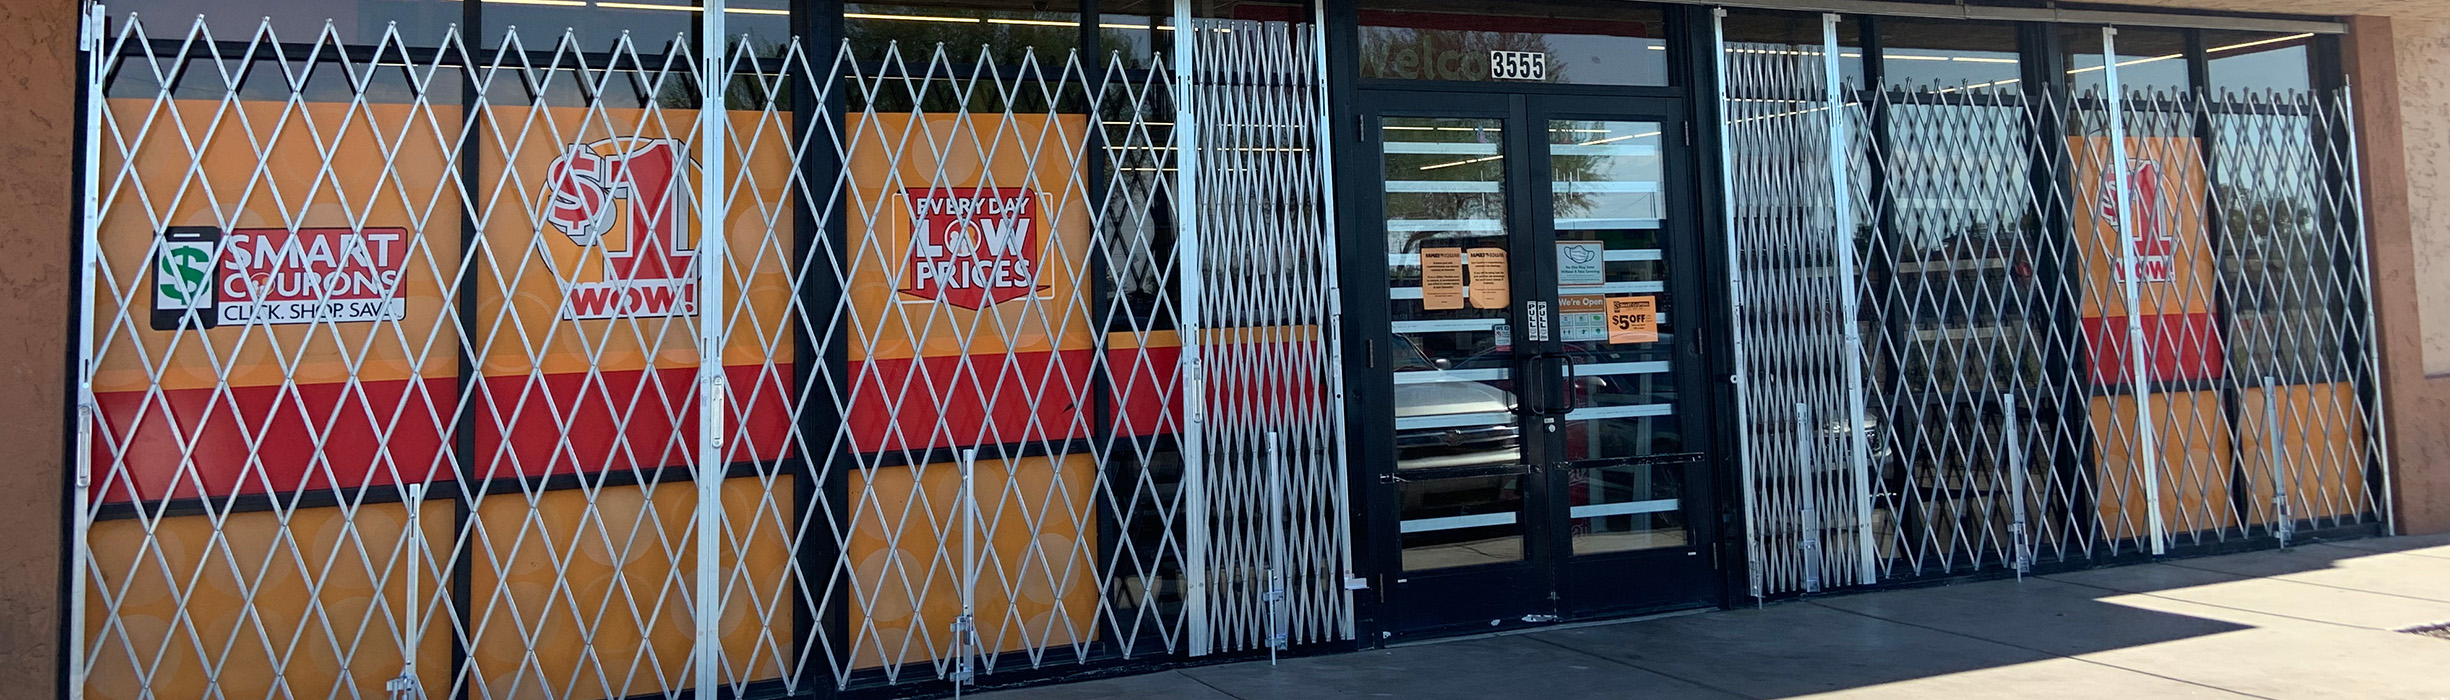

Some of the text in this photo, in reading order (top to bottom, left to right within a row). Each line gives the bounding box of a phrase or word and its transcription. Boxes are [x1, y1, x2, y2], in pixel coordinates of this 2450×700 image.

[1492, 51, 1544, 79] 3555
[547, 137, 698, 282] $1
[225, 233, 400, 270] SMART
[916, 218, 1031, 258] LOW
[224, 270, 400, 299] COUPONS
[916, 259, 1034, 290] PRICES
[349, 302, 397, 318] SAV.
[570, 284, 694, 316] WOW!
[1559, 297, 1603, 307] We're Open
[1528, 304, 1537, 328] PULL
[1538, 304, 1547, 328] PULL
[1612, 314, 1630, 330] $5
[1629, 314, 1646, 323] OFF
